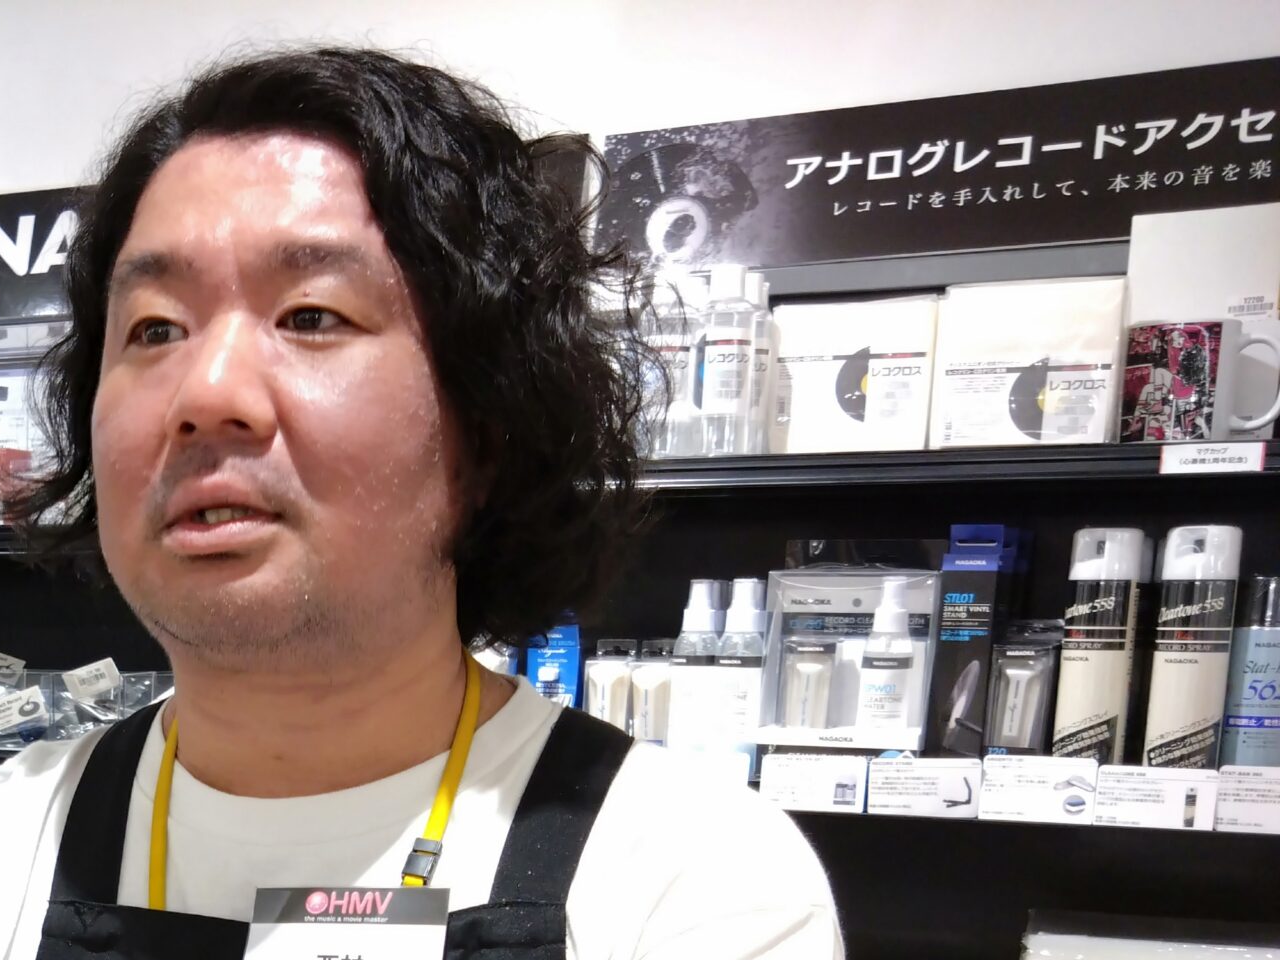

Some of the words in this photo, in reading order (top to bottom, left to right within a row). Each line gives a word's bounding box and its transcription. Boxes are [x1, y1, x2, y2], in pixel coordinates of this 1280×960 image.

[783, 107, 1277, 190] アナログレコードアクセ
[832, 159, 1273, 216] レコードを手入れして、本来の音を楽
[871, 366, 923, 377] レコクロス
[1049, 378, 1107, 392] レコクロス
[328, 890, 394, 915] HMV
[316, 915, 336, 923] music
